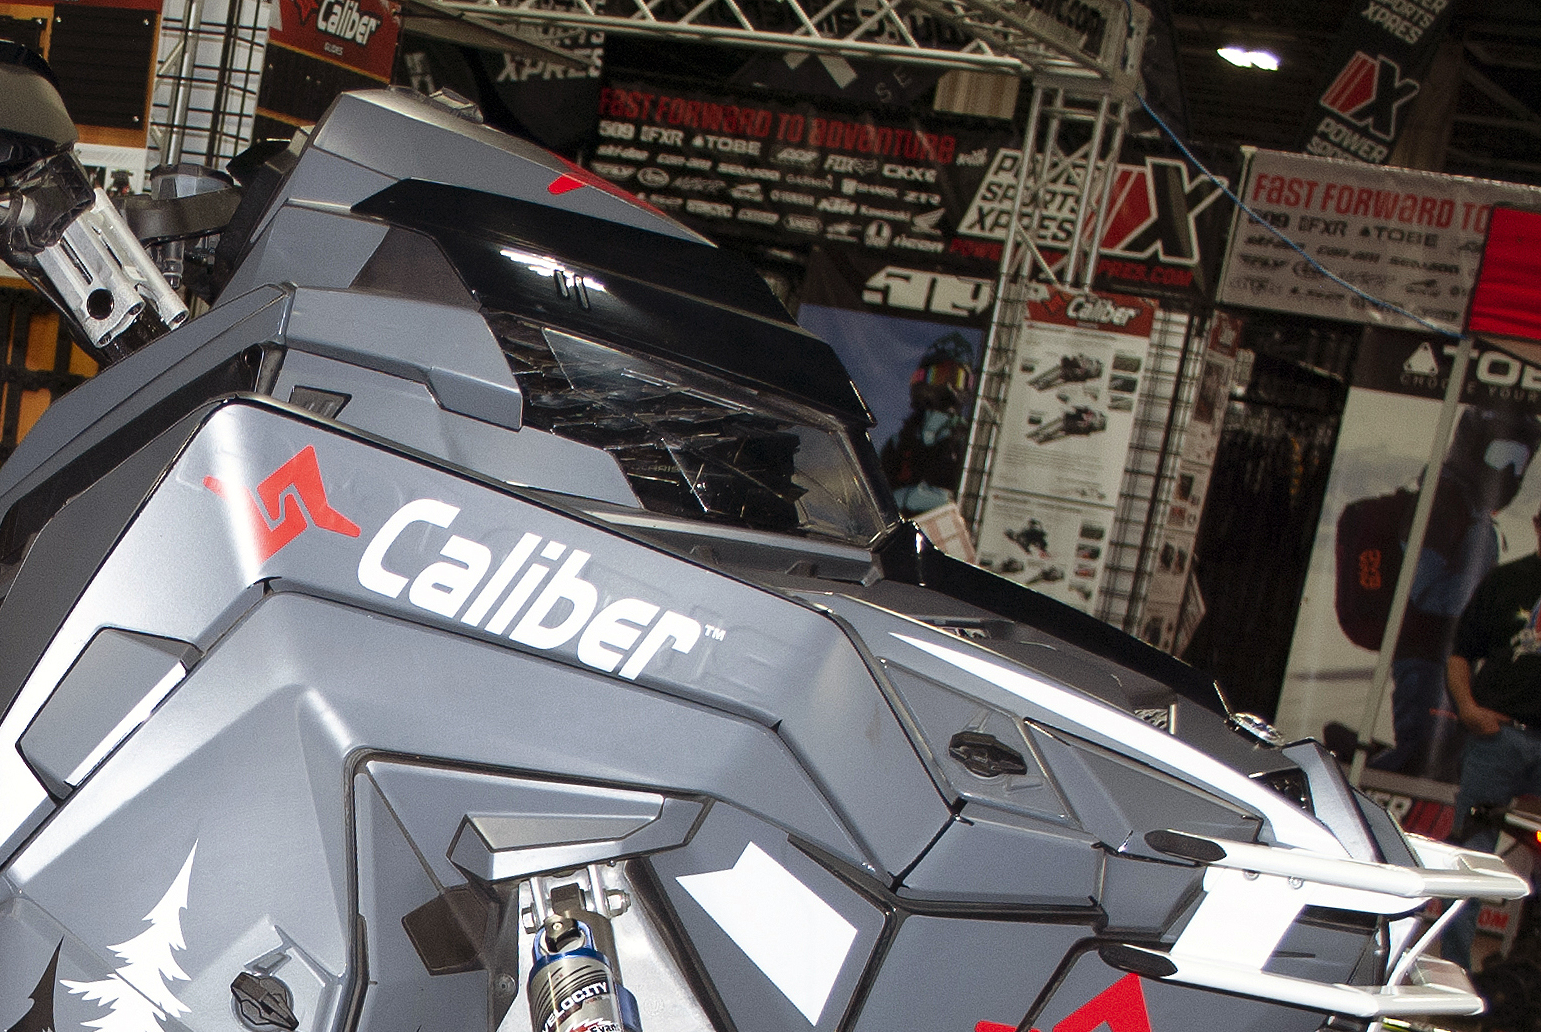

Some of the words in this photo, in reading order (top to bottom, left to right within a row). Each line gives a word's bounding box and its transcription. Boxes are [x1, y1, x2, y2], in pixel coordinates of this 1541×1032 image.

[316, 0, 380, 46] Caliber
[776, 112, 807, 143] TO
[1316, 117, 1389, 163] POWER
[705, 136, 762, 157] TOBE
[1373, 226, 1440, 249] TOBE
[1066, 296, 1138, 326] Caliber
[1399, 373, 1478, 395] CHOOE
[358, 498, 704, 680] Caliber
